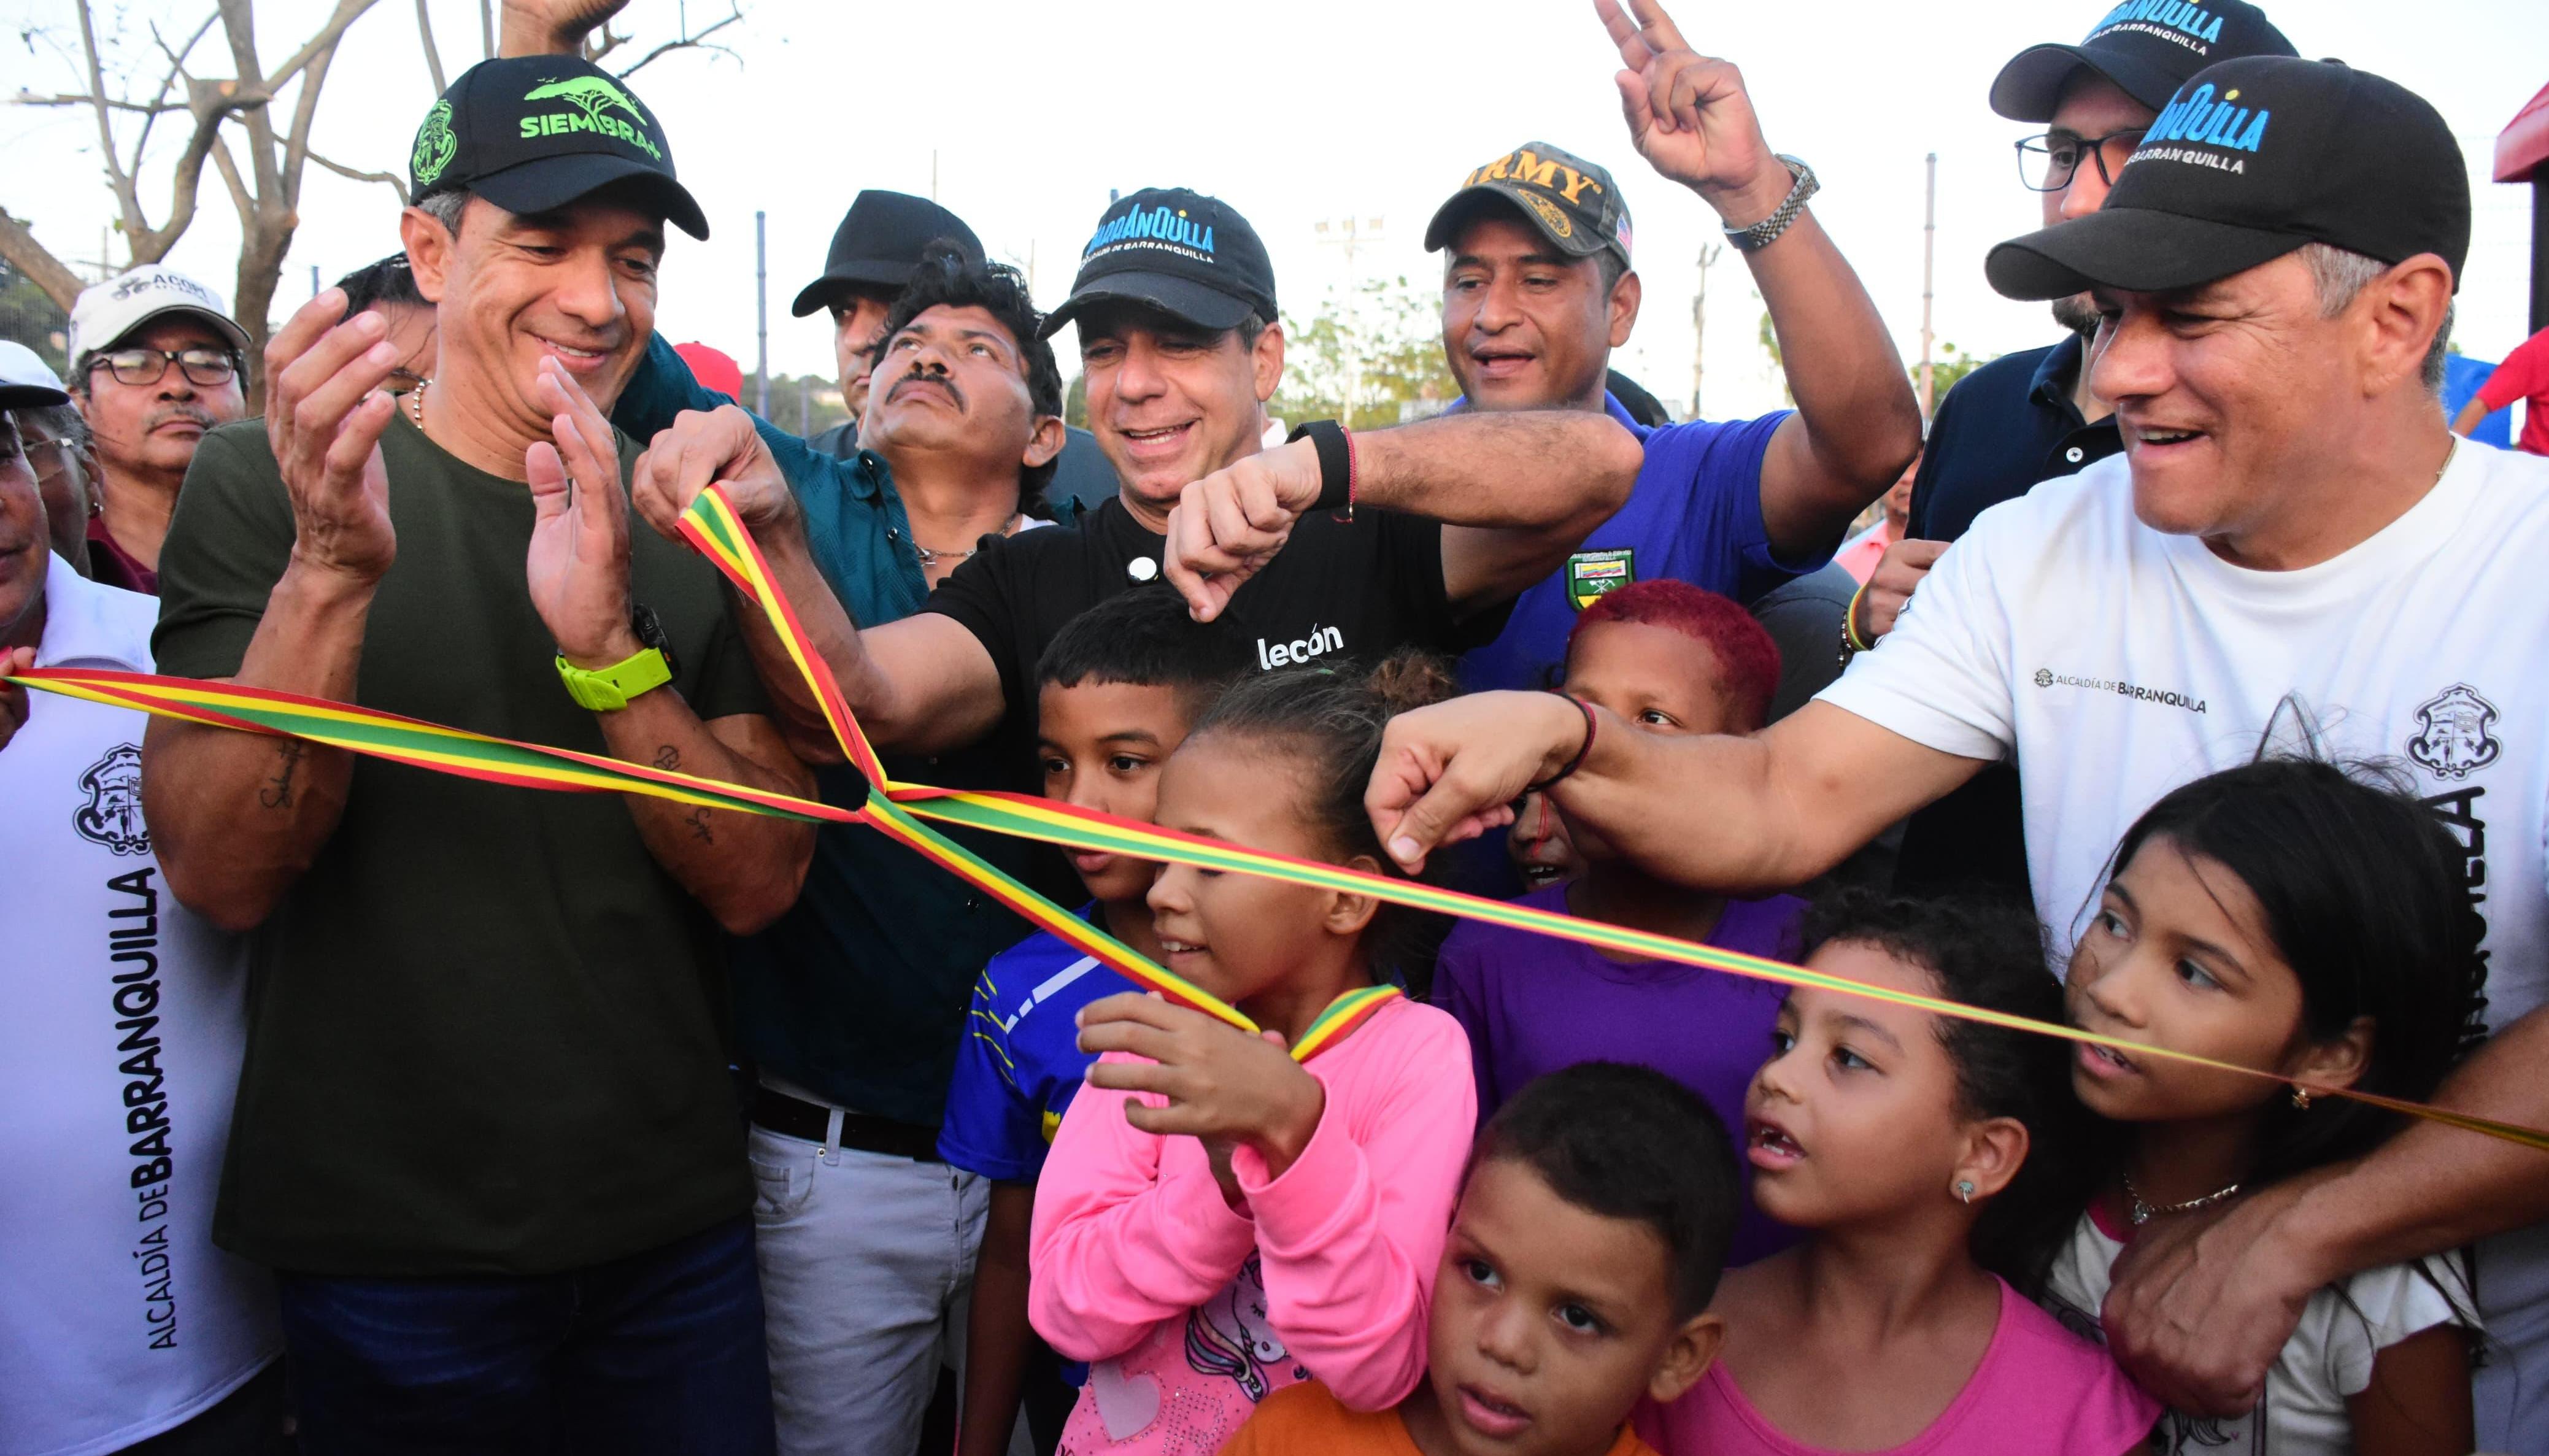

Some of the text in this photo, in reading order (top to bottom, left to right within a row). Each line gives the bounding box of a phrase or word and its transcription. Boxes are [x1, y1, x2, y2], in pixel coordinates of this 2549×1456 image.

[2111, 23, 2207, 56] BARRANQUILLA
[1124, 241, 1214, 264] BARRANQUILLA
[1258, 623, 1344, 670] lecón
[2056, 675, 2207, 714] ALCALDÍA DE BARRANQUILLA
[107, 867, 177, 1349] ALCALDÍA DE BARRANQUILLA
